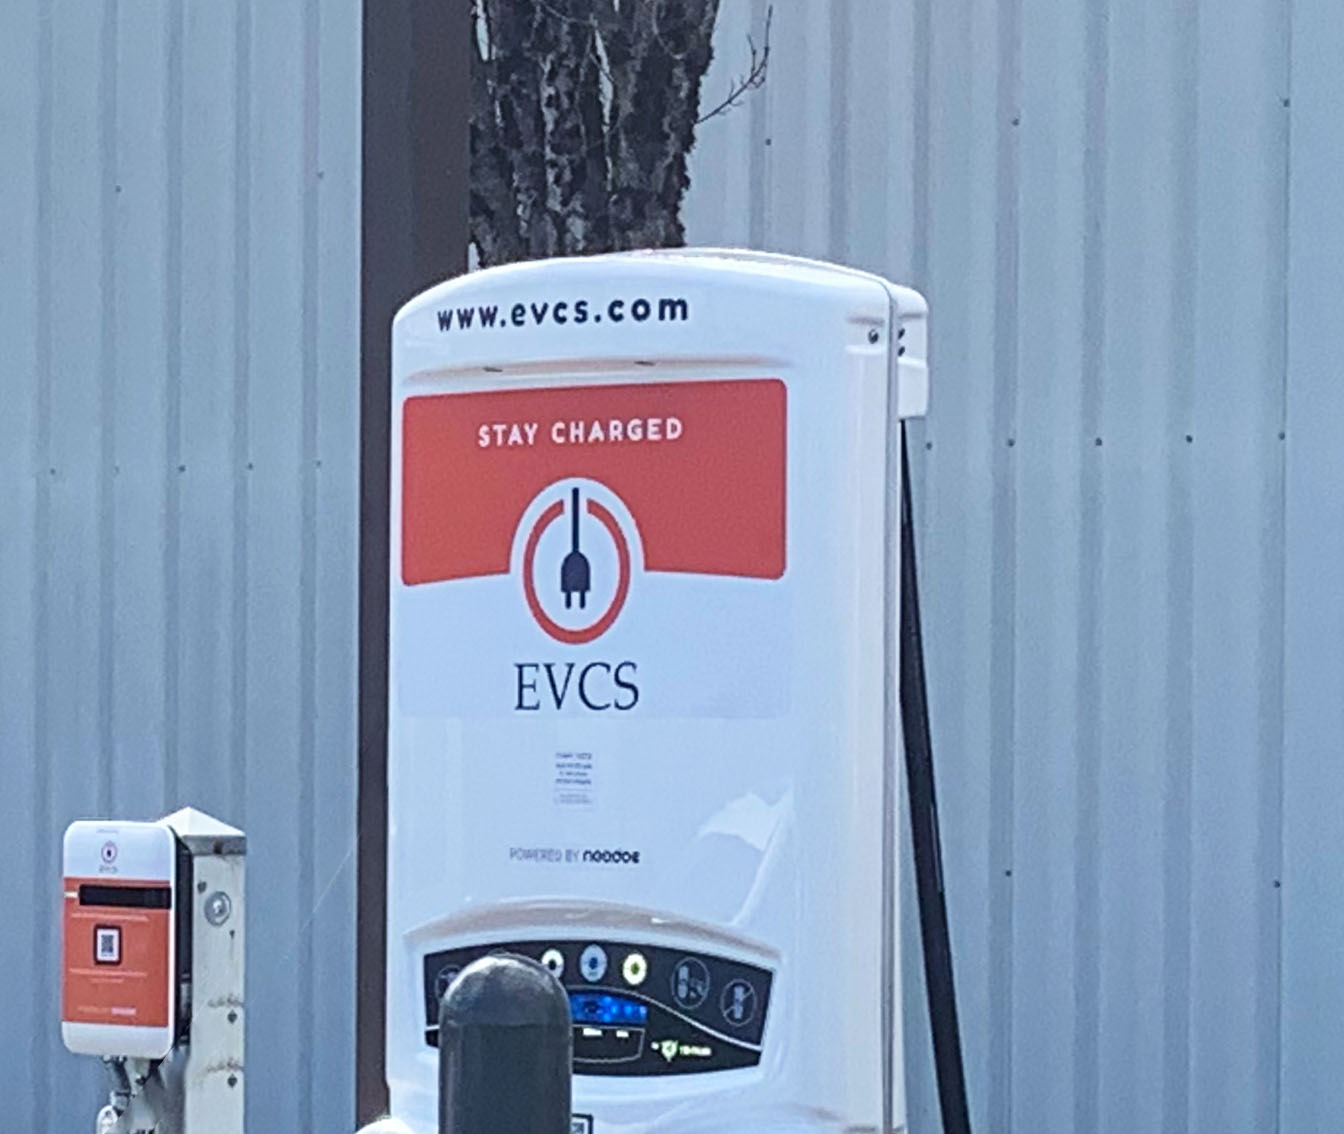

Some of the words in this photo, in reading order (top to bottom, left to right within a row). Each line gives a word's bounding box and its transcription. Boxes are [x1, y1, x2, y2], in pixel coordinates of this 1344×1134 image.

[437, 299, 689, 332] www.evcs.com
[477, 422, 539, 448] STAY
[551, 416, 684, 445] CHARGED
[513, 660, 640, 711] EVCS
